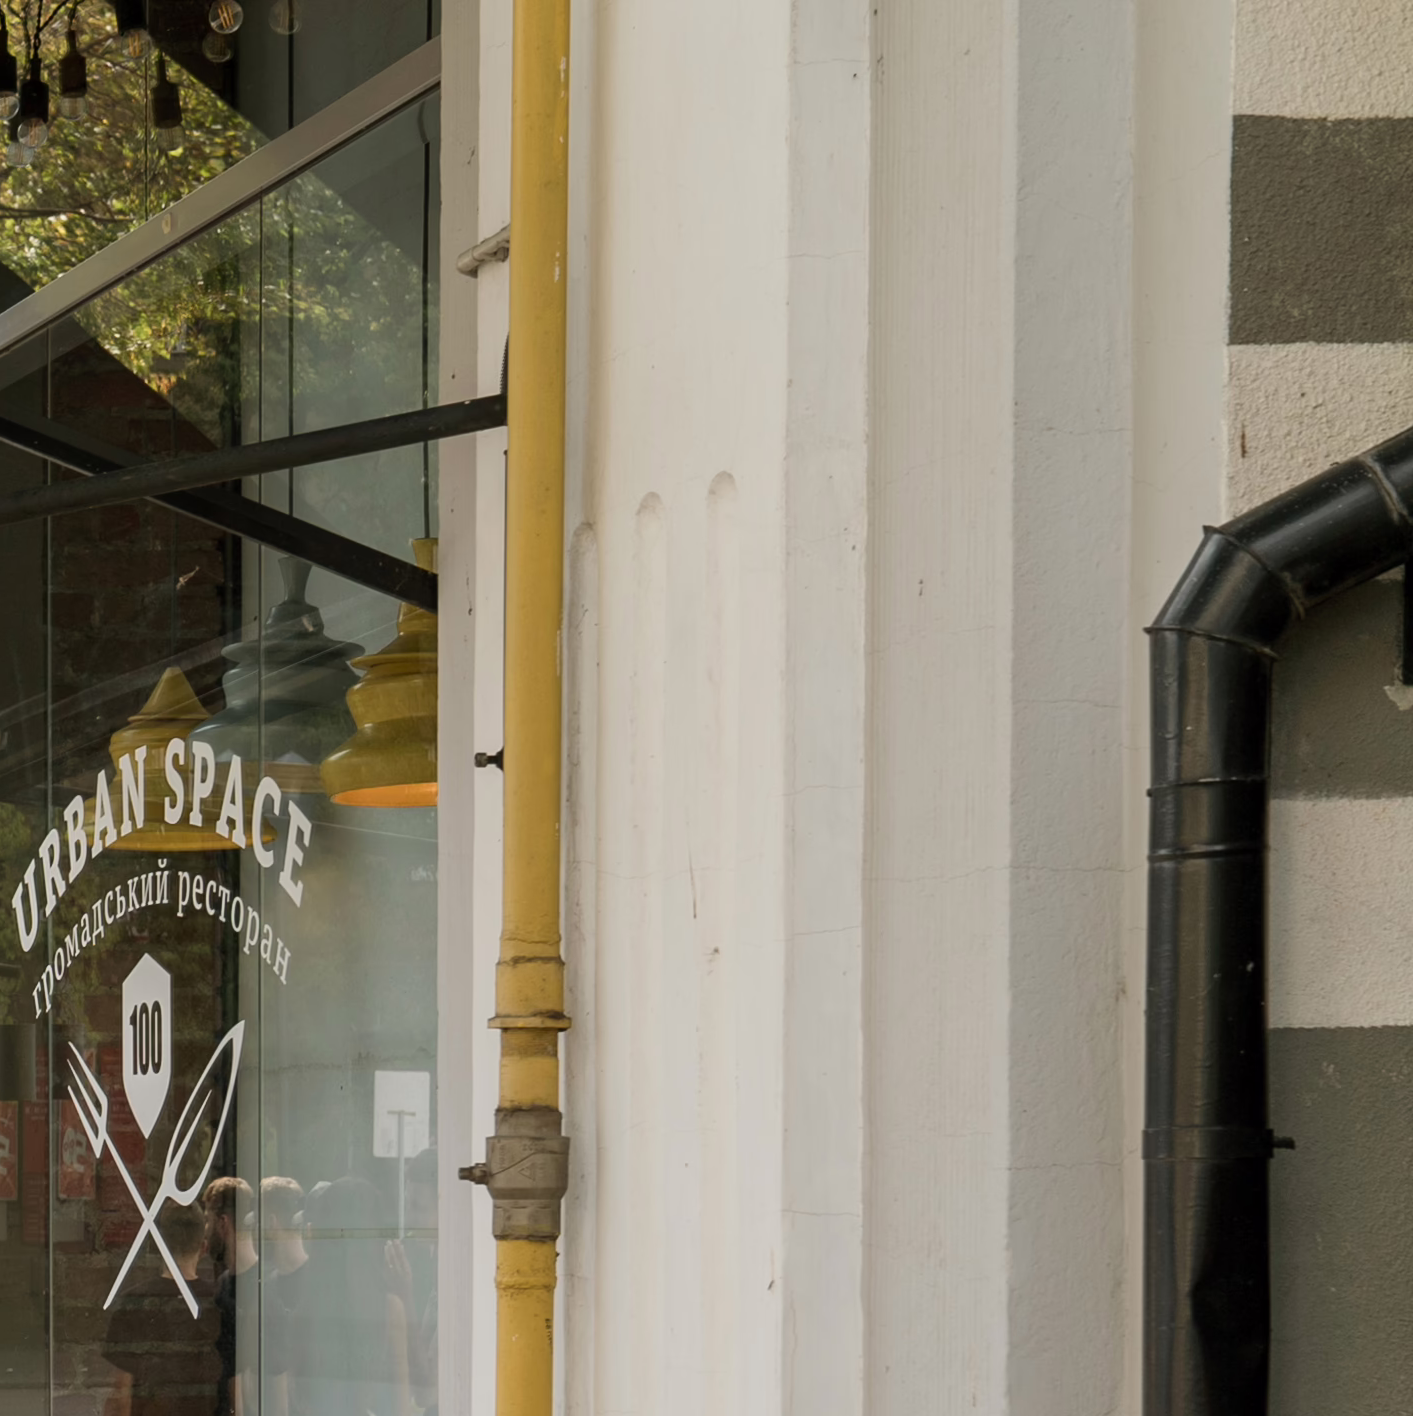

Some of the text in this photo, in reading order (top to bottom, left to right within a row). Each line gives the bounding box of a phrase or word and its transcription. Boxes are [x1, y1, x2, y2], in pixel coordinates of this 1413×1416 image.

[11, 737, 313, 952] URBAN SPACE
[31, 858, 291, 1019] громадський ресторан
[129, 1000, 163, 1076] 100
